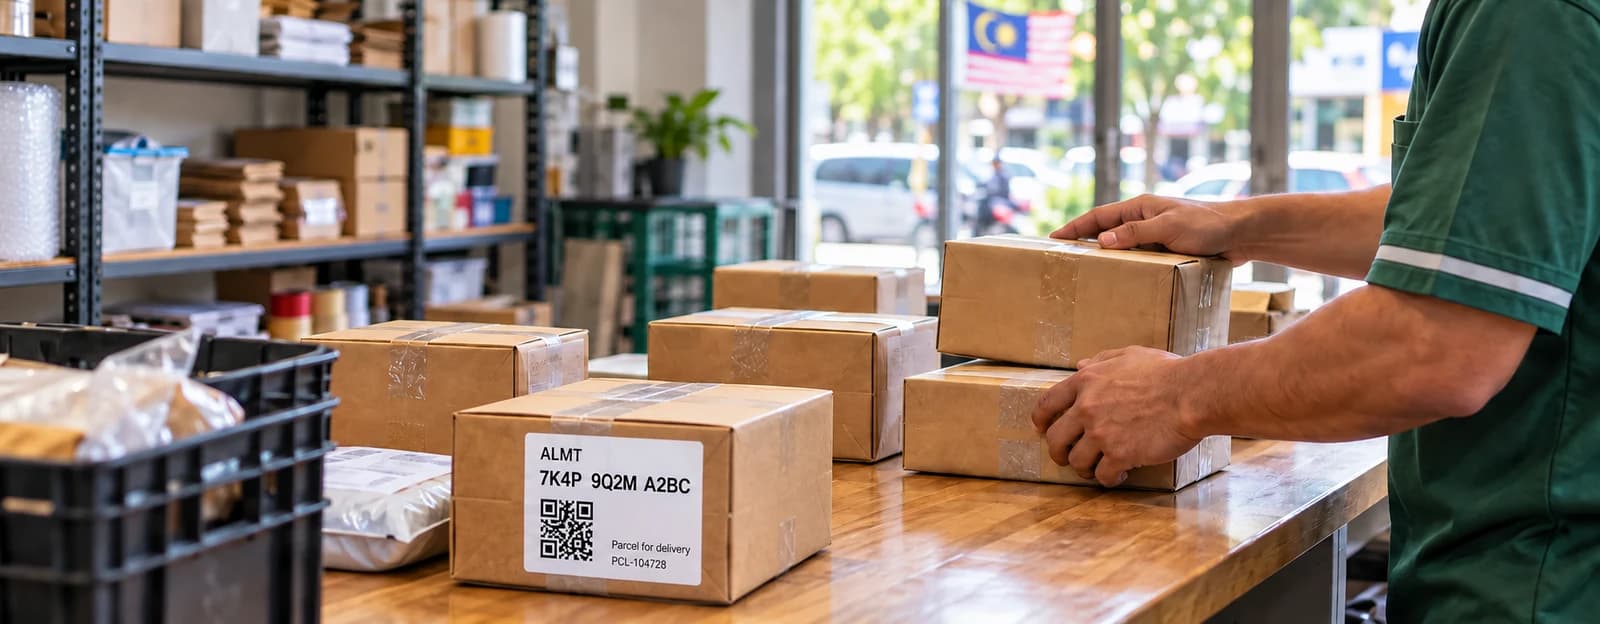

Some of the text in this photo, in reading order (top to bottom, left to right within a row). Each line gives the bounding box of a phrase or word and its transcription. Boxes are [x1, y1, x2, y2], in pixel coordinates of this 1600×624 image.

[540, 447, 582, 462] ALMT
[539, 470, 691, 494] 7K4P 9Q2M A2BC
[611, 540, 691, 557] Parcel for delivery
[611, 556, 667, 570] PCL-104728
